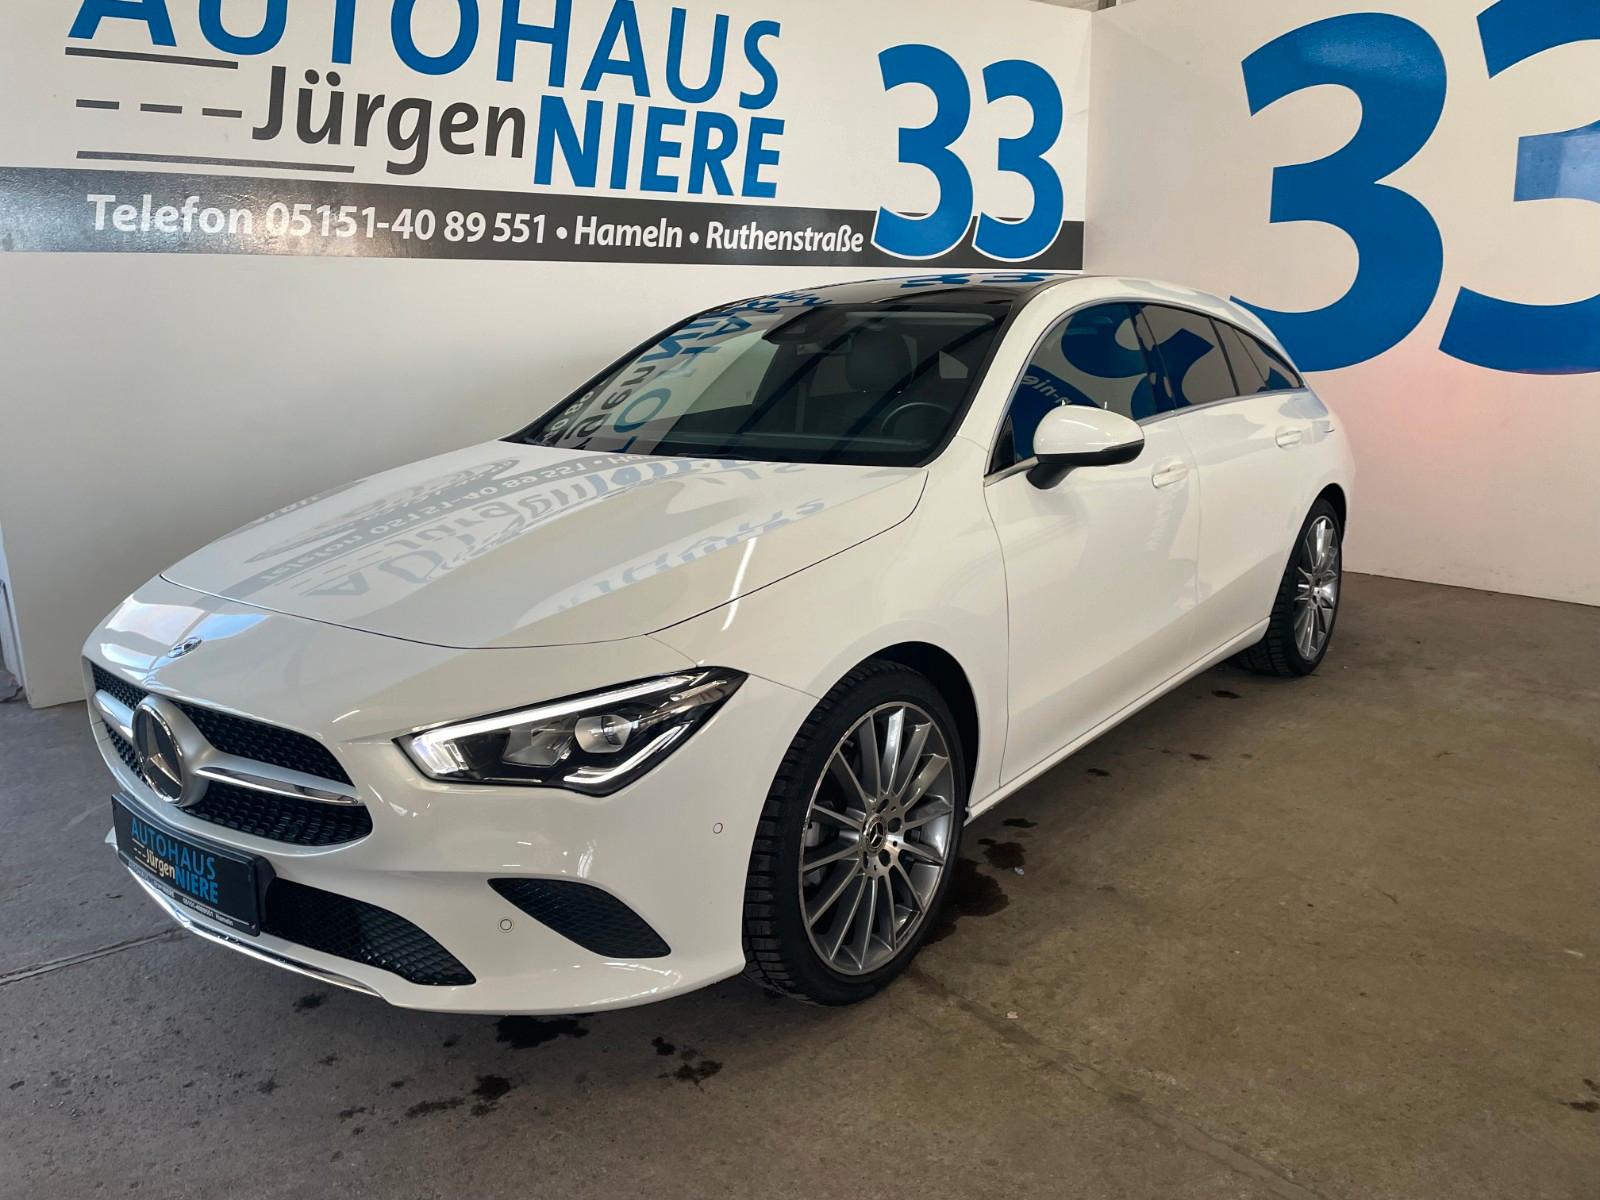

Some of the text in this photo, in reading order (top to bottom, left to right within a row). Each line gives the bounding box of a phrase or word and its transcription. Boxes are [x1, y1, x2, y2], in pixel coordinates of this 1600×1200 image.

[87, 194, 865, 253] Telefon 05151-40 89 551 Hameln Ruthenstraße
[871, 43, 1065, 262] 33
[1229, 0, 1600, 375] 33
[131, 816, 216, 881] AUTOHAUS
